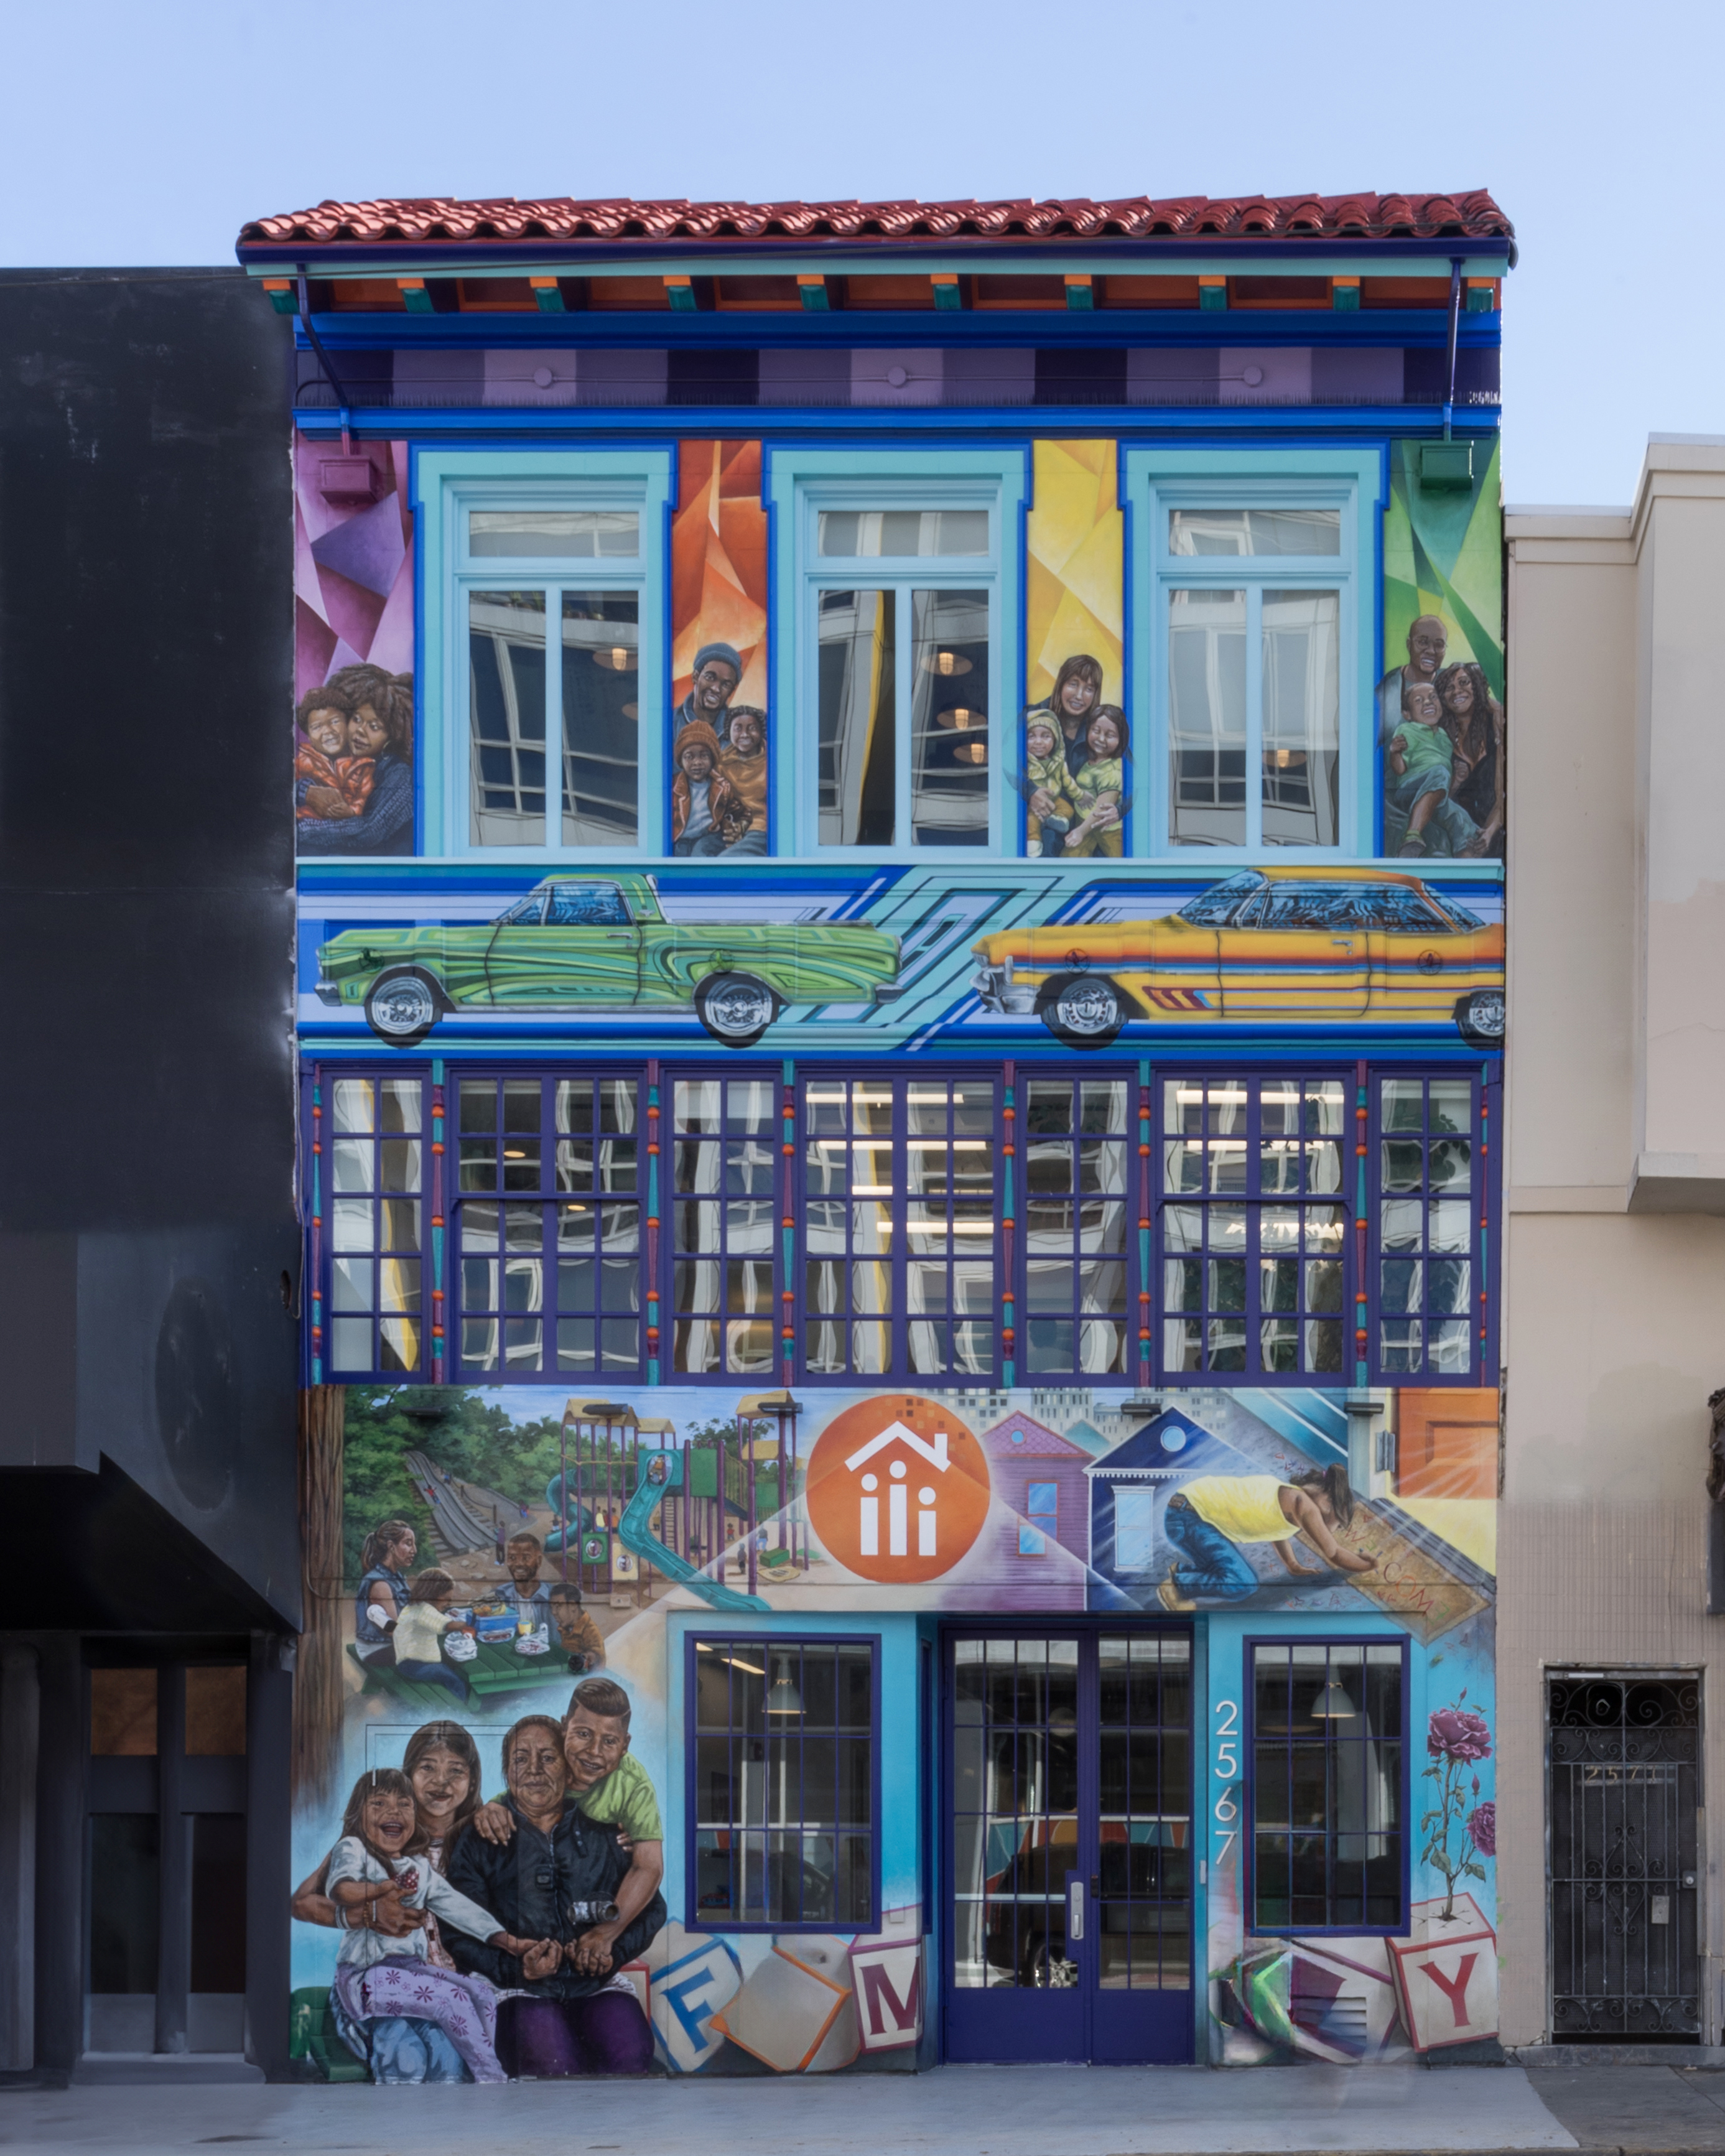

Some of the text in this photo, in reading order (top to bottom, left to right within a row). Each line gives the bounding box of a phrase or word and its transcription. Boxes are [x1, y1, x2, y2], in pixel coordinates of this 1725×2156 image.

[1214, 1699, 1239, 1866] 2567
[660, 1966, 715, 2053] F
[858, 1955, 923, 2036] M
[1417, 1952, 1479, 2028] Y
